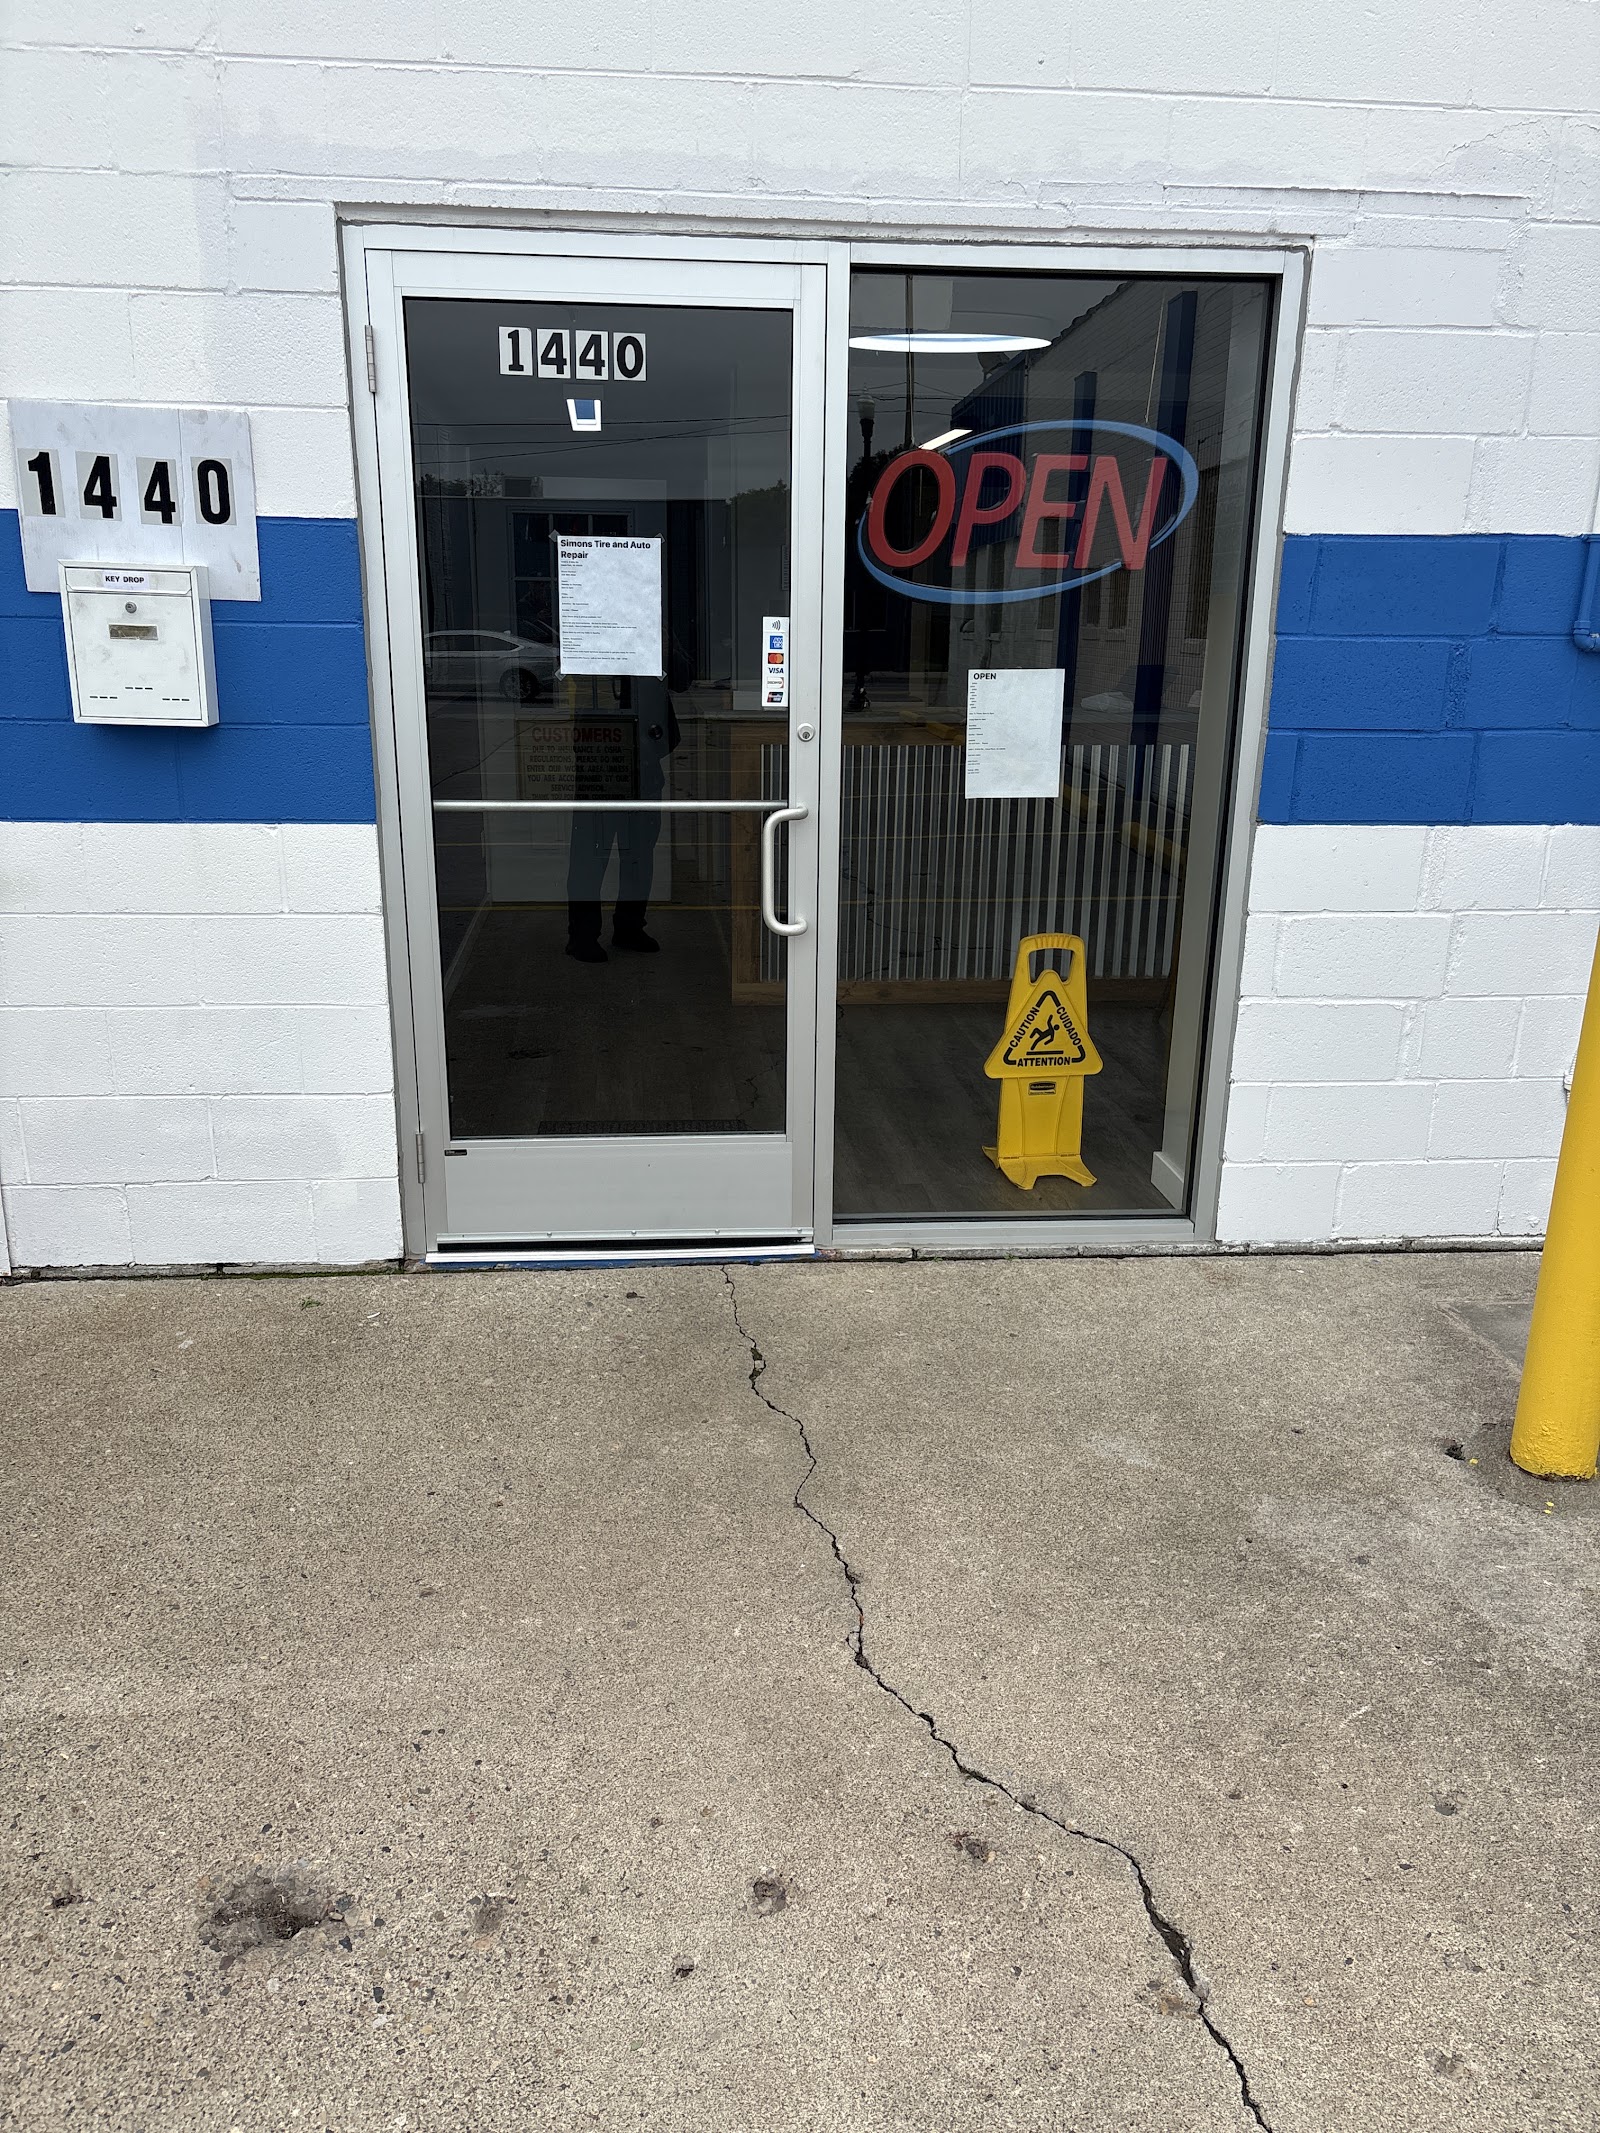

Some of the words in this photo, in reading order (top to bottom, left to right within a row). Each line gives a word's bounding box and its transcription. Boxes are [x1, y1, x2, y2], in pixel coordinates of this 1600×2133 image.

[507, 329, 644, 379] 1440
[28, 452, 231, 525] 1440
[868, 449, 1168, 570] OPEN
[560, 539, 593, 548] Simons
[594, 540, 611, 548] Tire
[612, 541, 629, 549] and
[630, 541, 651, 549] Auto
[560, 551, 589, 560] Repair
[105, 575, 120, 583] KEY
[122, 576, 145, 584] DROP
[973, 672, 997, 680] OPEN
[532, 727, 623, 743] CUSTOMERS
[547, 745, 556, 753] TO
[527, 765, 546, 773] ENTER
[548, 765, 562, 773] OUR
[527, 774, 541, 783] YOU
[543, 774, 556, 783] ARE
[551, 784, 575, 792] SERVICE
[1009, 1007, 1040, 1048] CAUTION
[1056, 1006, 1082, 1046] CUIDADO
[1017, 1056, 1071, 1067] ATTENTION
